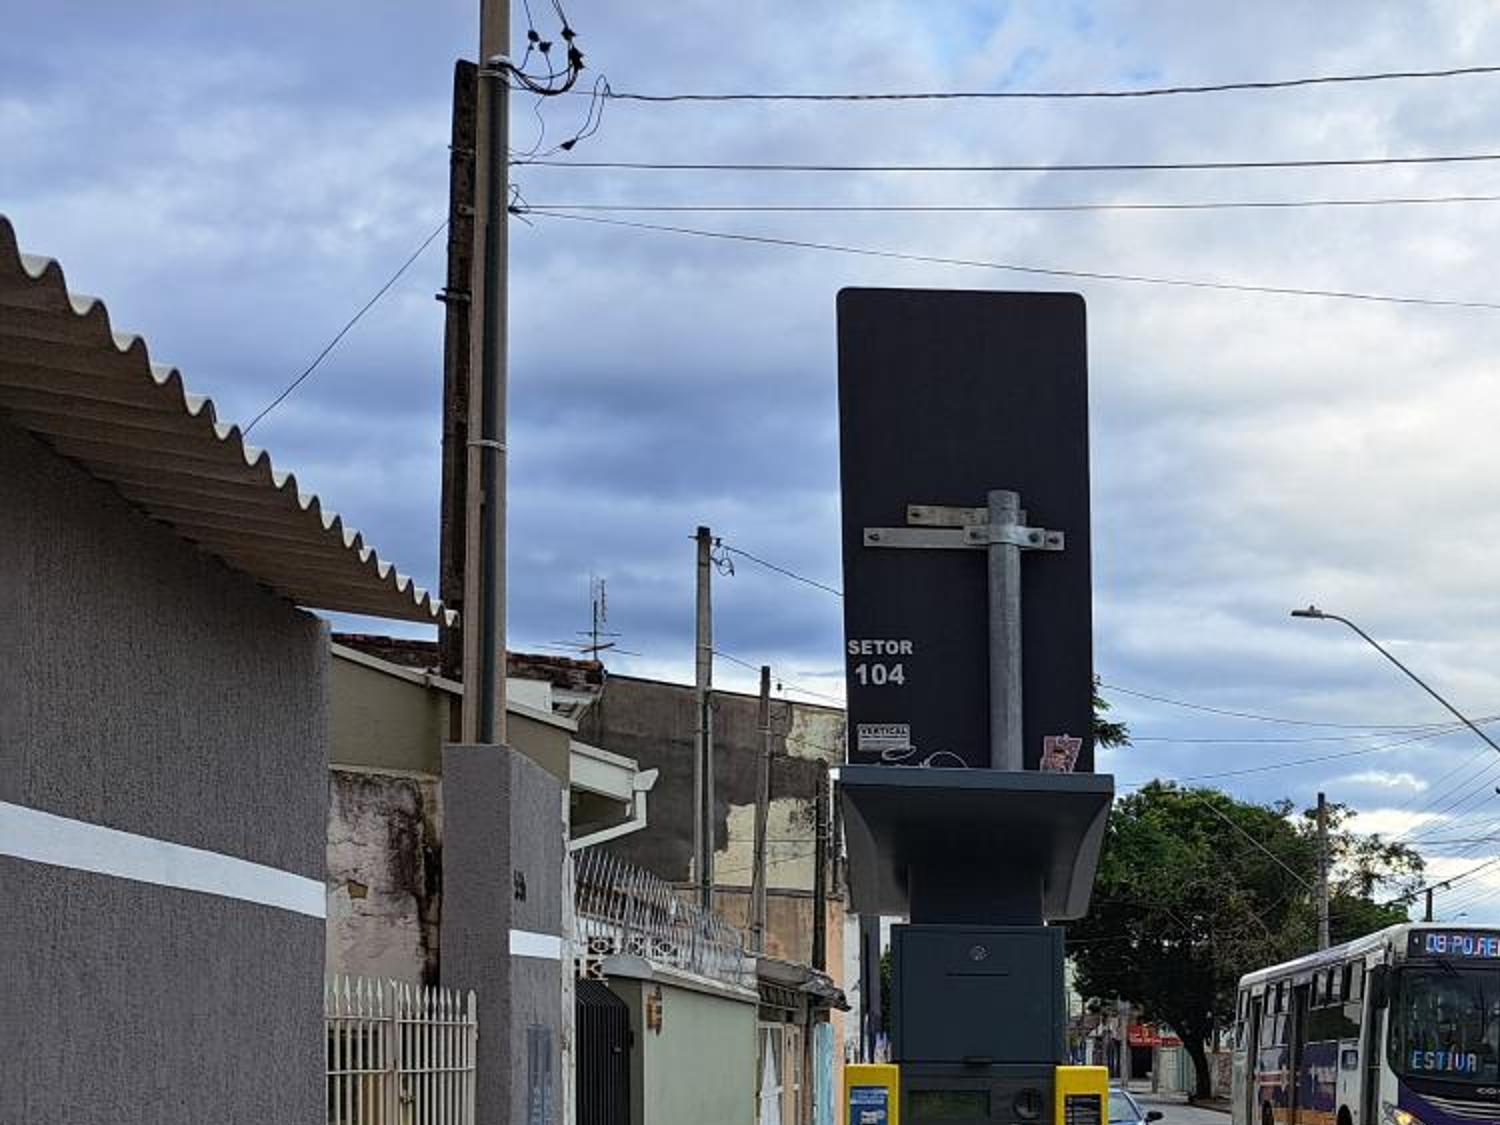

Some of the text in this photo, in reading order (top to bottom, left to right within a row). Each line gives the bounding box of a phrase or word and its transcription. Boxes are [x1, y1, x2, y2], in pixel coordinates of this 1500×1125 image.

[848, 639, 913, 655] SETOR
[855, 663, 905, 685] 104
[1412, 1050, 1477, 1072] ESTIVA
